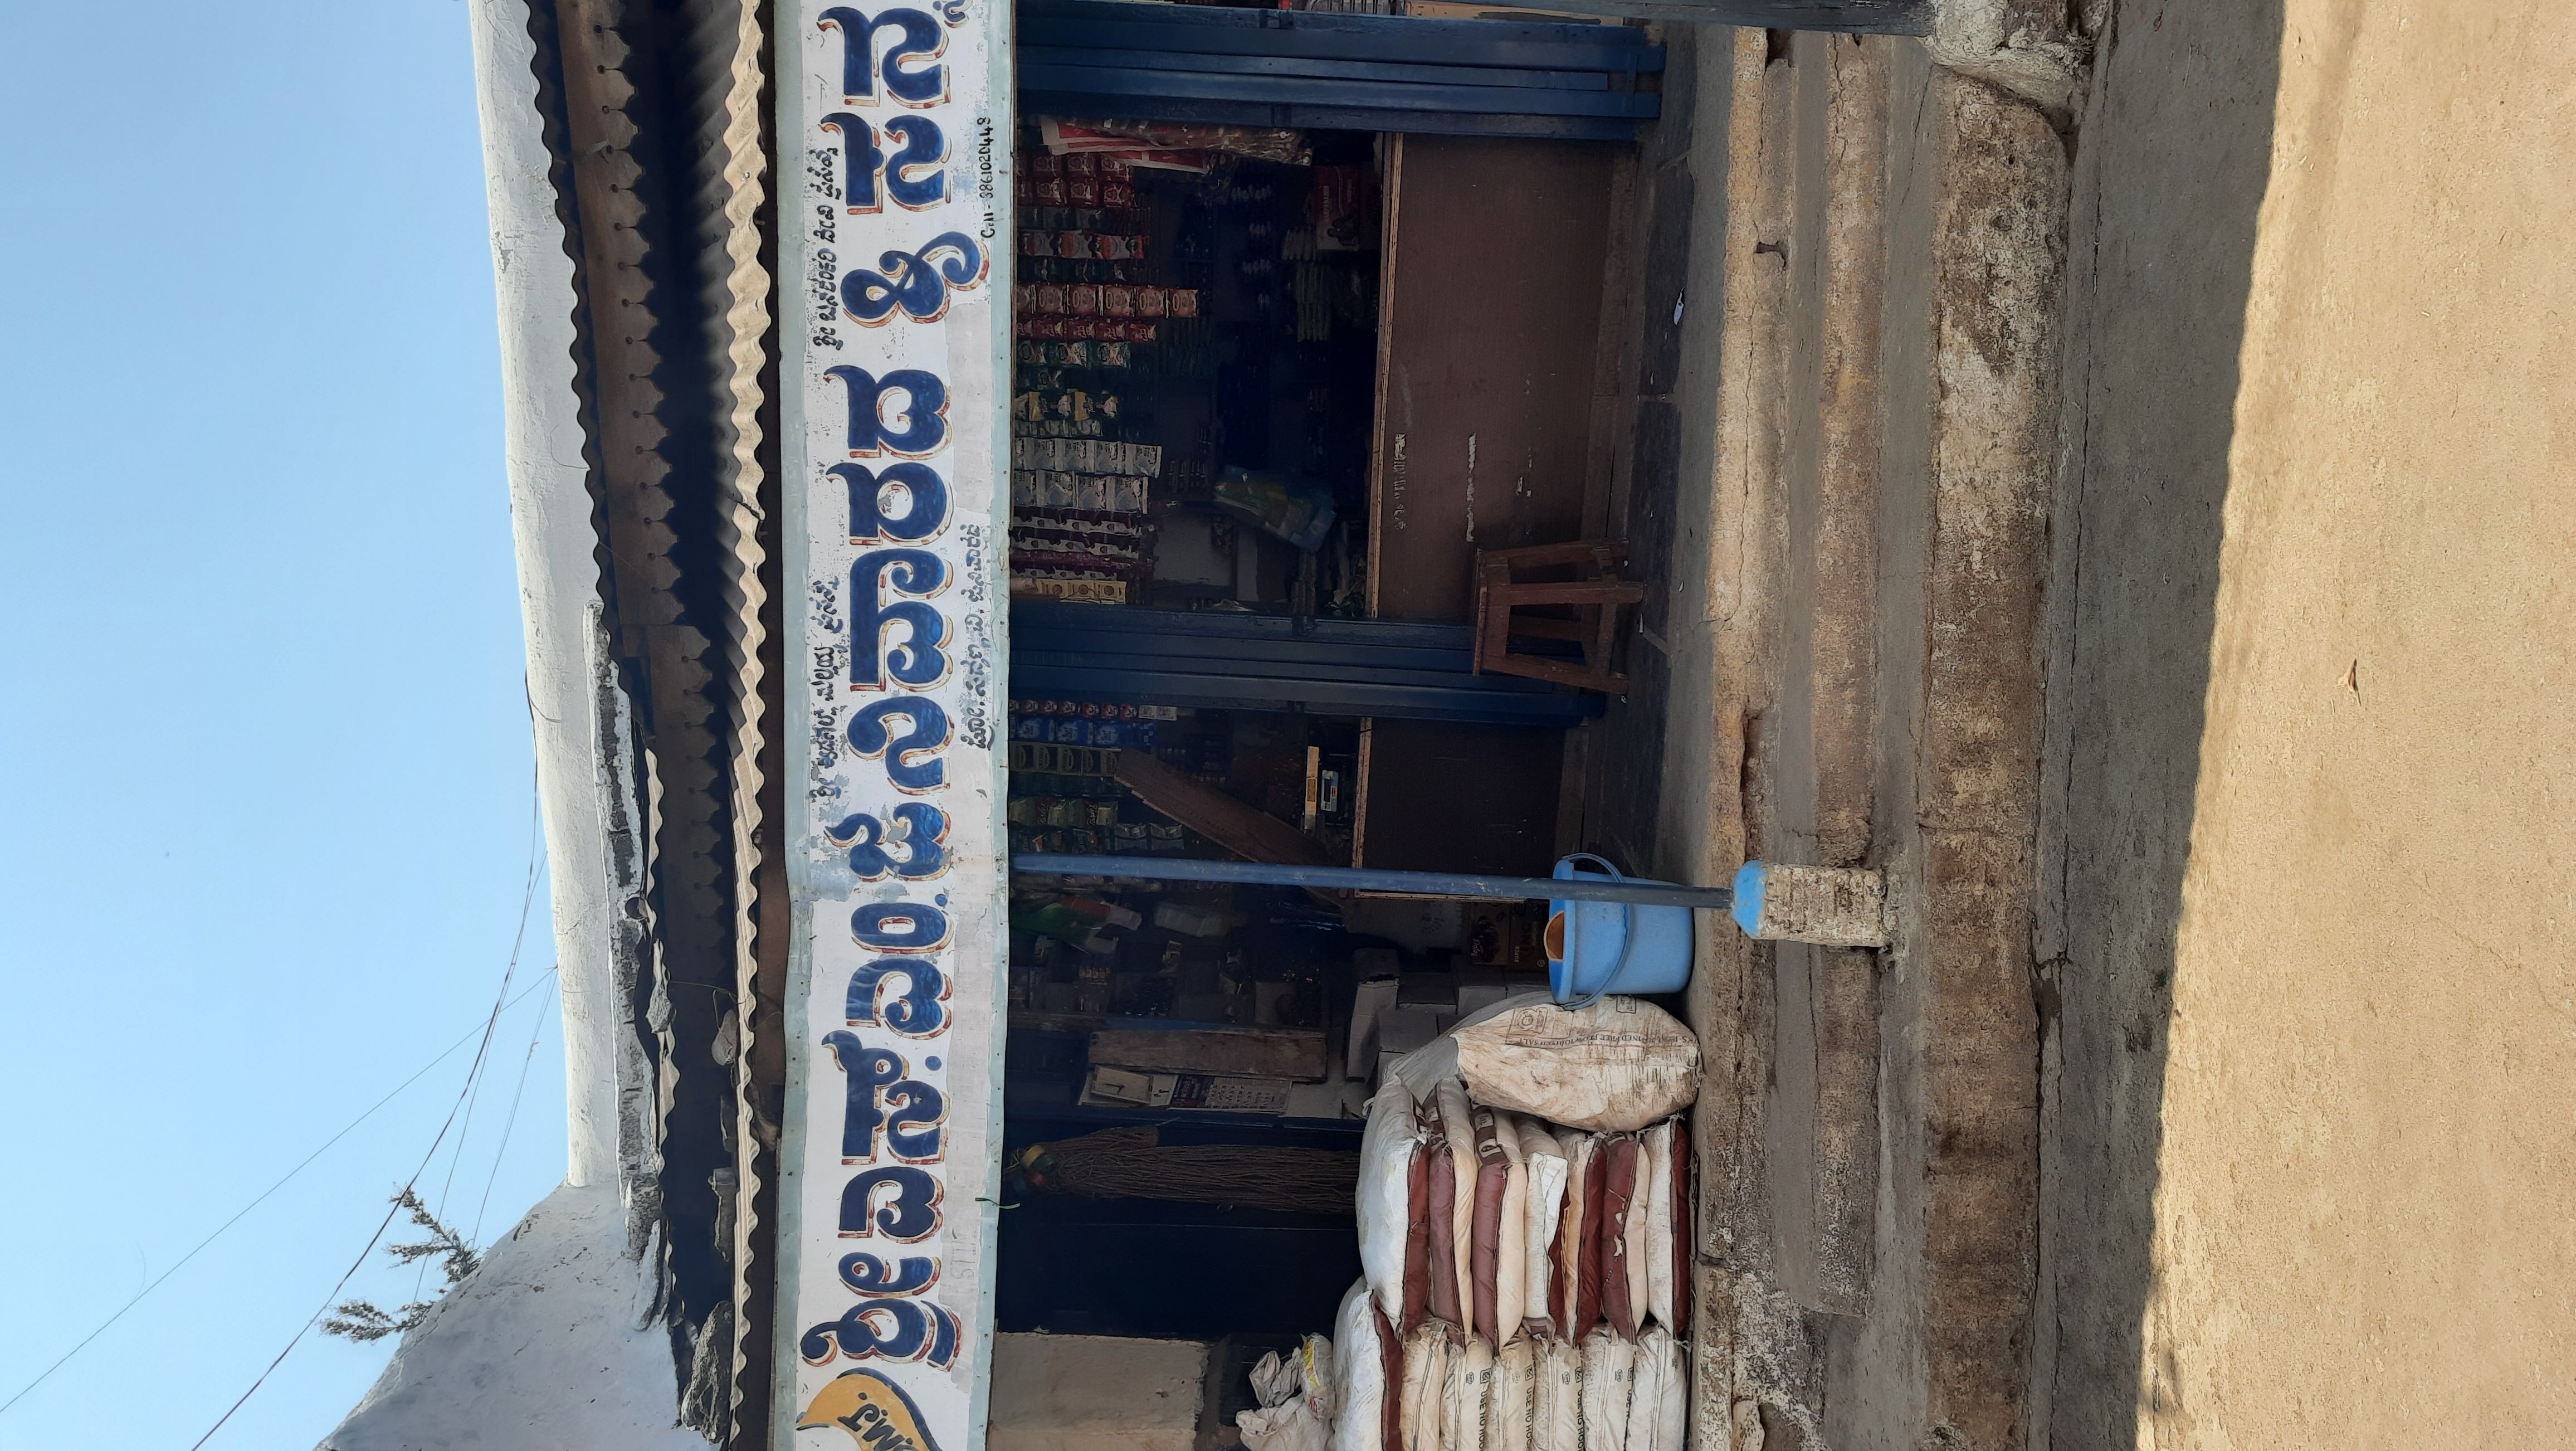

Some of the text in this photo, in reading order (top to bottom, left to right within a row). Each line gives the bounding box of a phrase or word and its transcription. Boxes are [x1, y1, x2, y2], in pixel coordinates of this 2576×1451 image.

[812, 204, 836, 243] ದೇವಿ
[812, 327, 843, 350] ಶ್ರೀ
[1519, 1038, 1539, 1046] SALT
[800, 1252, 962, 1371] ಶ್ರೀ
[1479, 1390, 1487, 1410] USE
[837, 1392, 920, 1451] .M.J.
[1479, 1411, 1486, 1426] NO
[1525, 1408, 1532, 1423] NO
